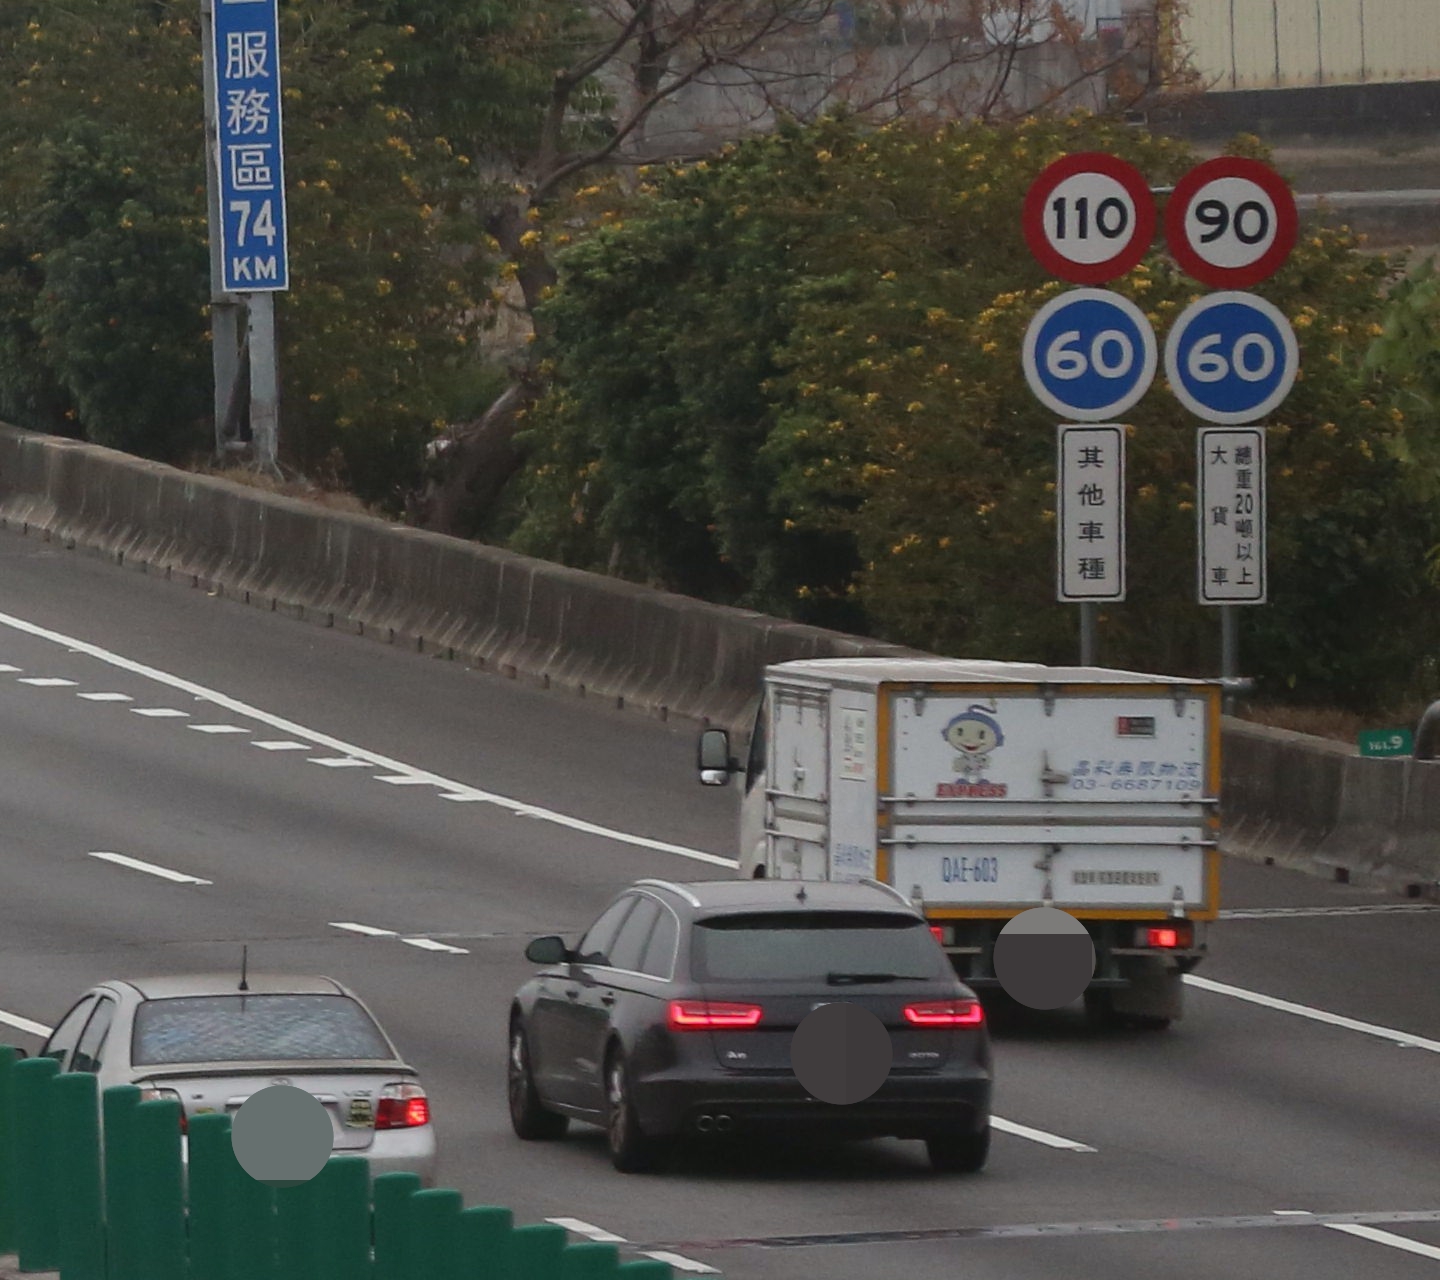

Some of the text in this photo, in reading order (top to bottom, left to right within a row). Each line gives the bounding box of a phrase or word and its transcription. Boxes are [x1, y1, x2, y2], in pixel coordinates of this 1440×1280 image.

[229, 199, 277, 248] 74
[1052, 196, 1129, 240] 110
[1195, 199, 1269, 244] 90
[232, 255, 277, 282] KM
[1046, 329, 1134, 380] 60
[1187, 333, 1275, 383] 60
[1077, 445, 1106, 581] 其他車種
[1210, 445, 1229, 586] 大貨車
